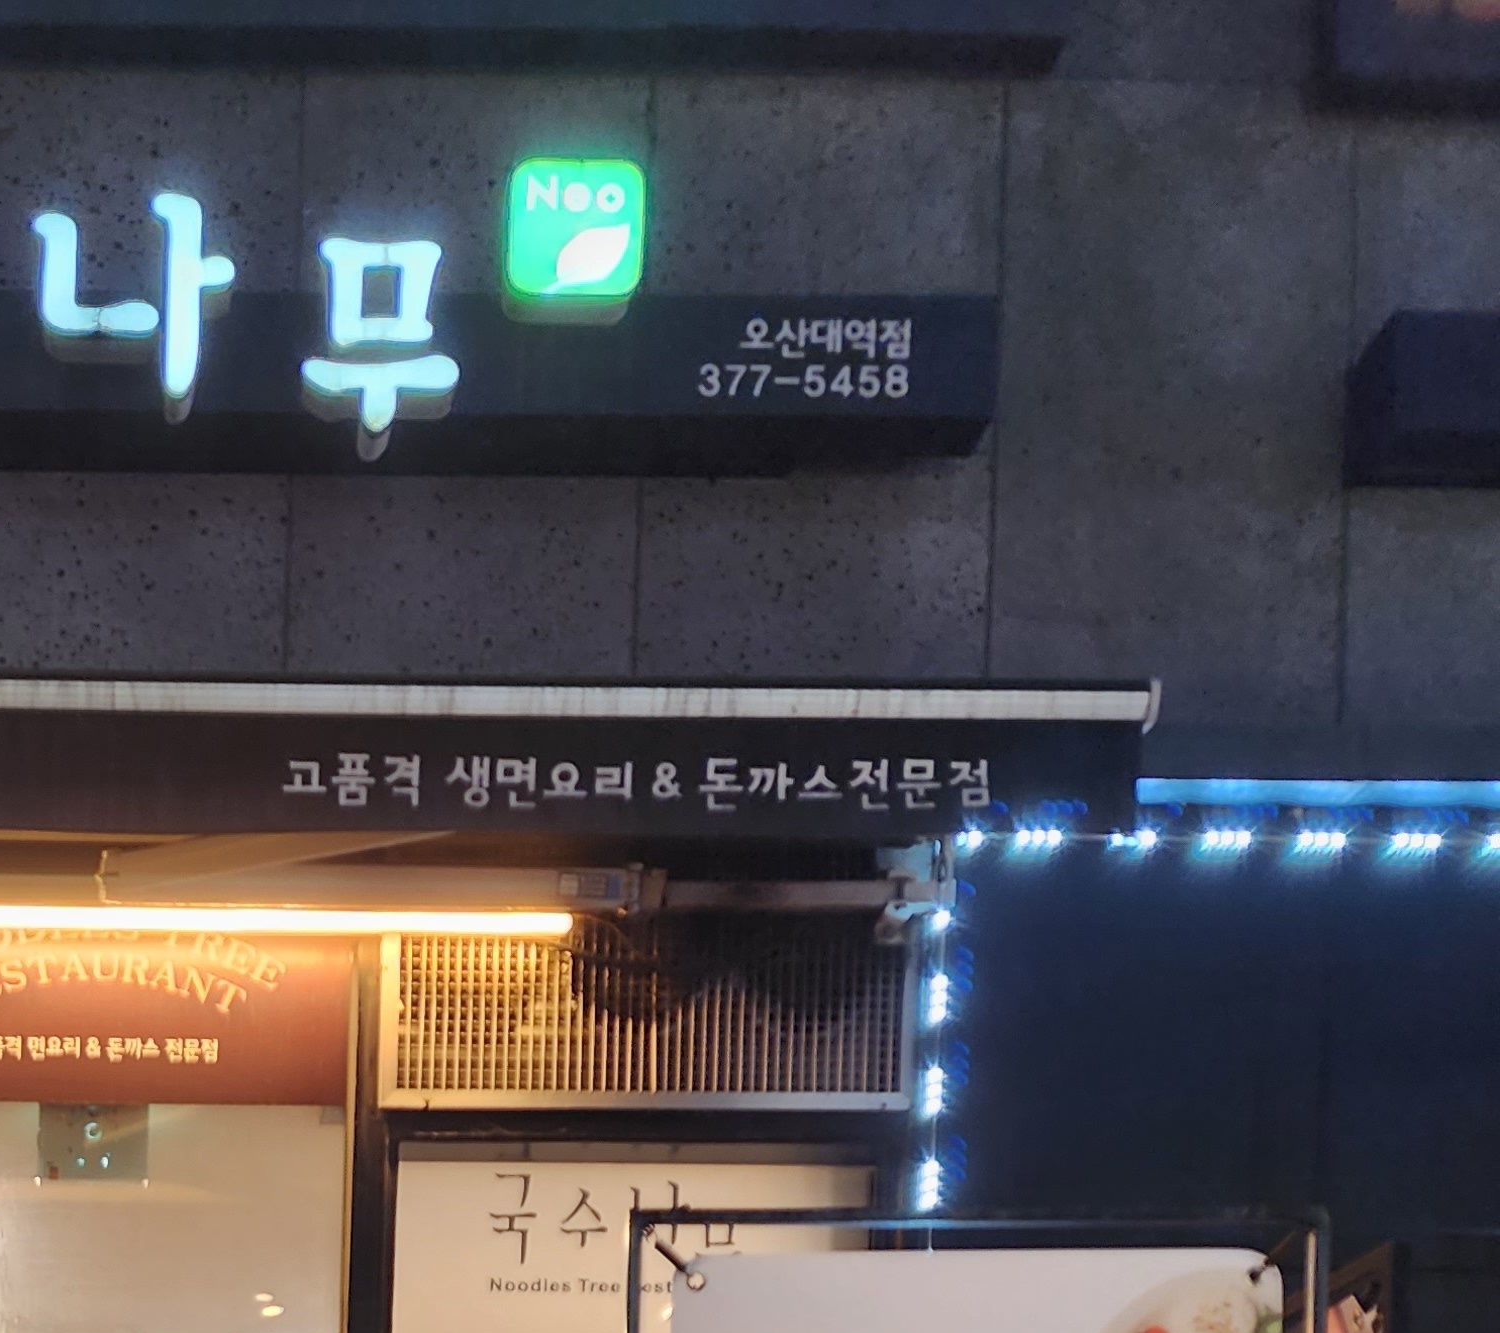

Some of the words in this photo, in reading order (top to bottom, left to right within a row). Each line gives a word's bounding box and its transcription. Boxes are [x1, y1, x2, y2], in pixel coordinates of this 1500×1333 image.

[525, 174, 626, 213] Neo
[739, 317, 913, 359] 오산대역점
[698, 364, 910, 400] 377-5458
[282, 752, 423, 806] 고품격
[445, 755, 635, 809] 생면요리
[651, 766, 683, 799] &
[698, 756, 991, 811] 돈까스전문점
[26, 1035, 82, 1063] 면요리
[85, 1036, 102, 1060] &
[105, 1036, 161, 1064] 돈까스
[163, 1037, 220, 1065] 전문점
[489, 1277, 572, 1293] Noodles
[577, 1278, 621, 1293] Tree
